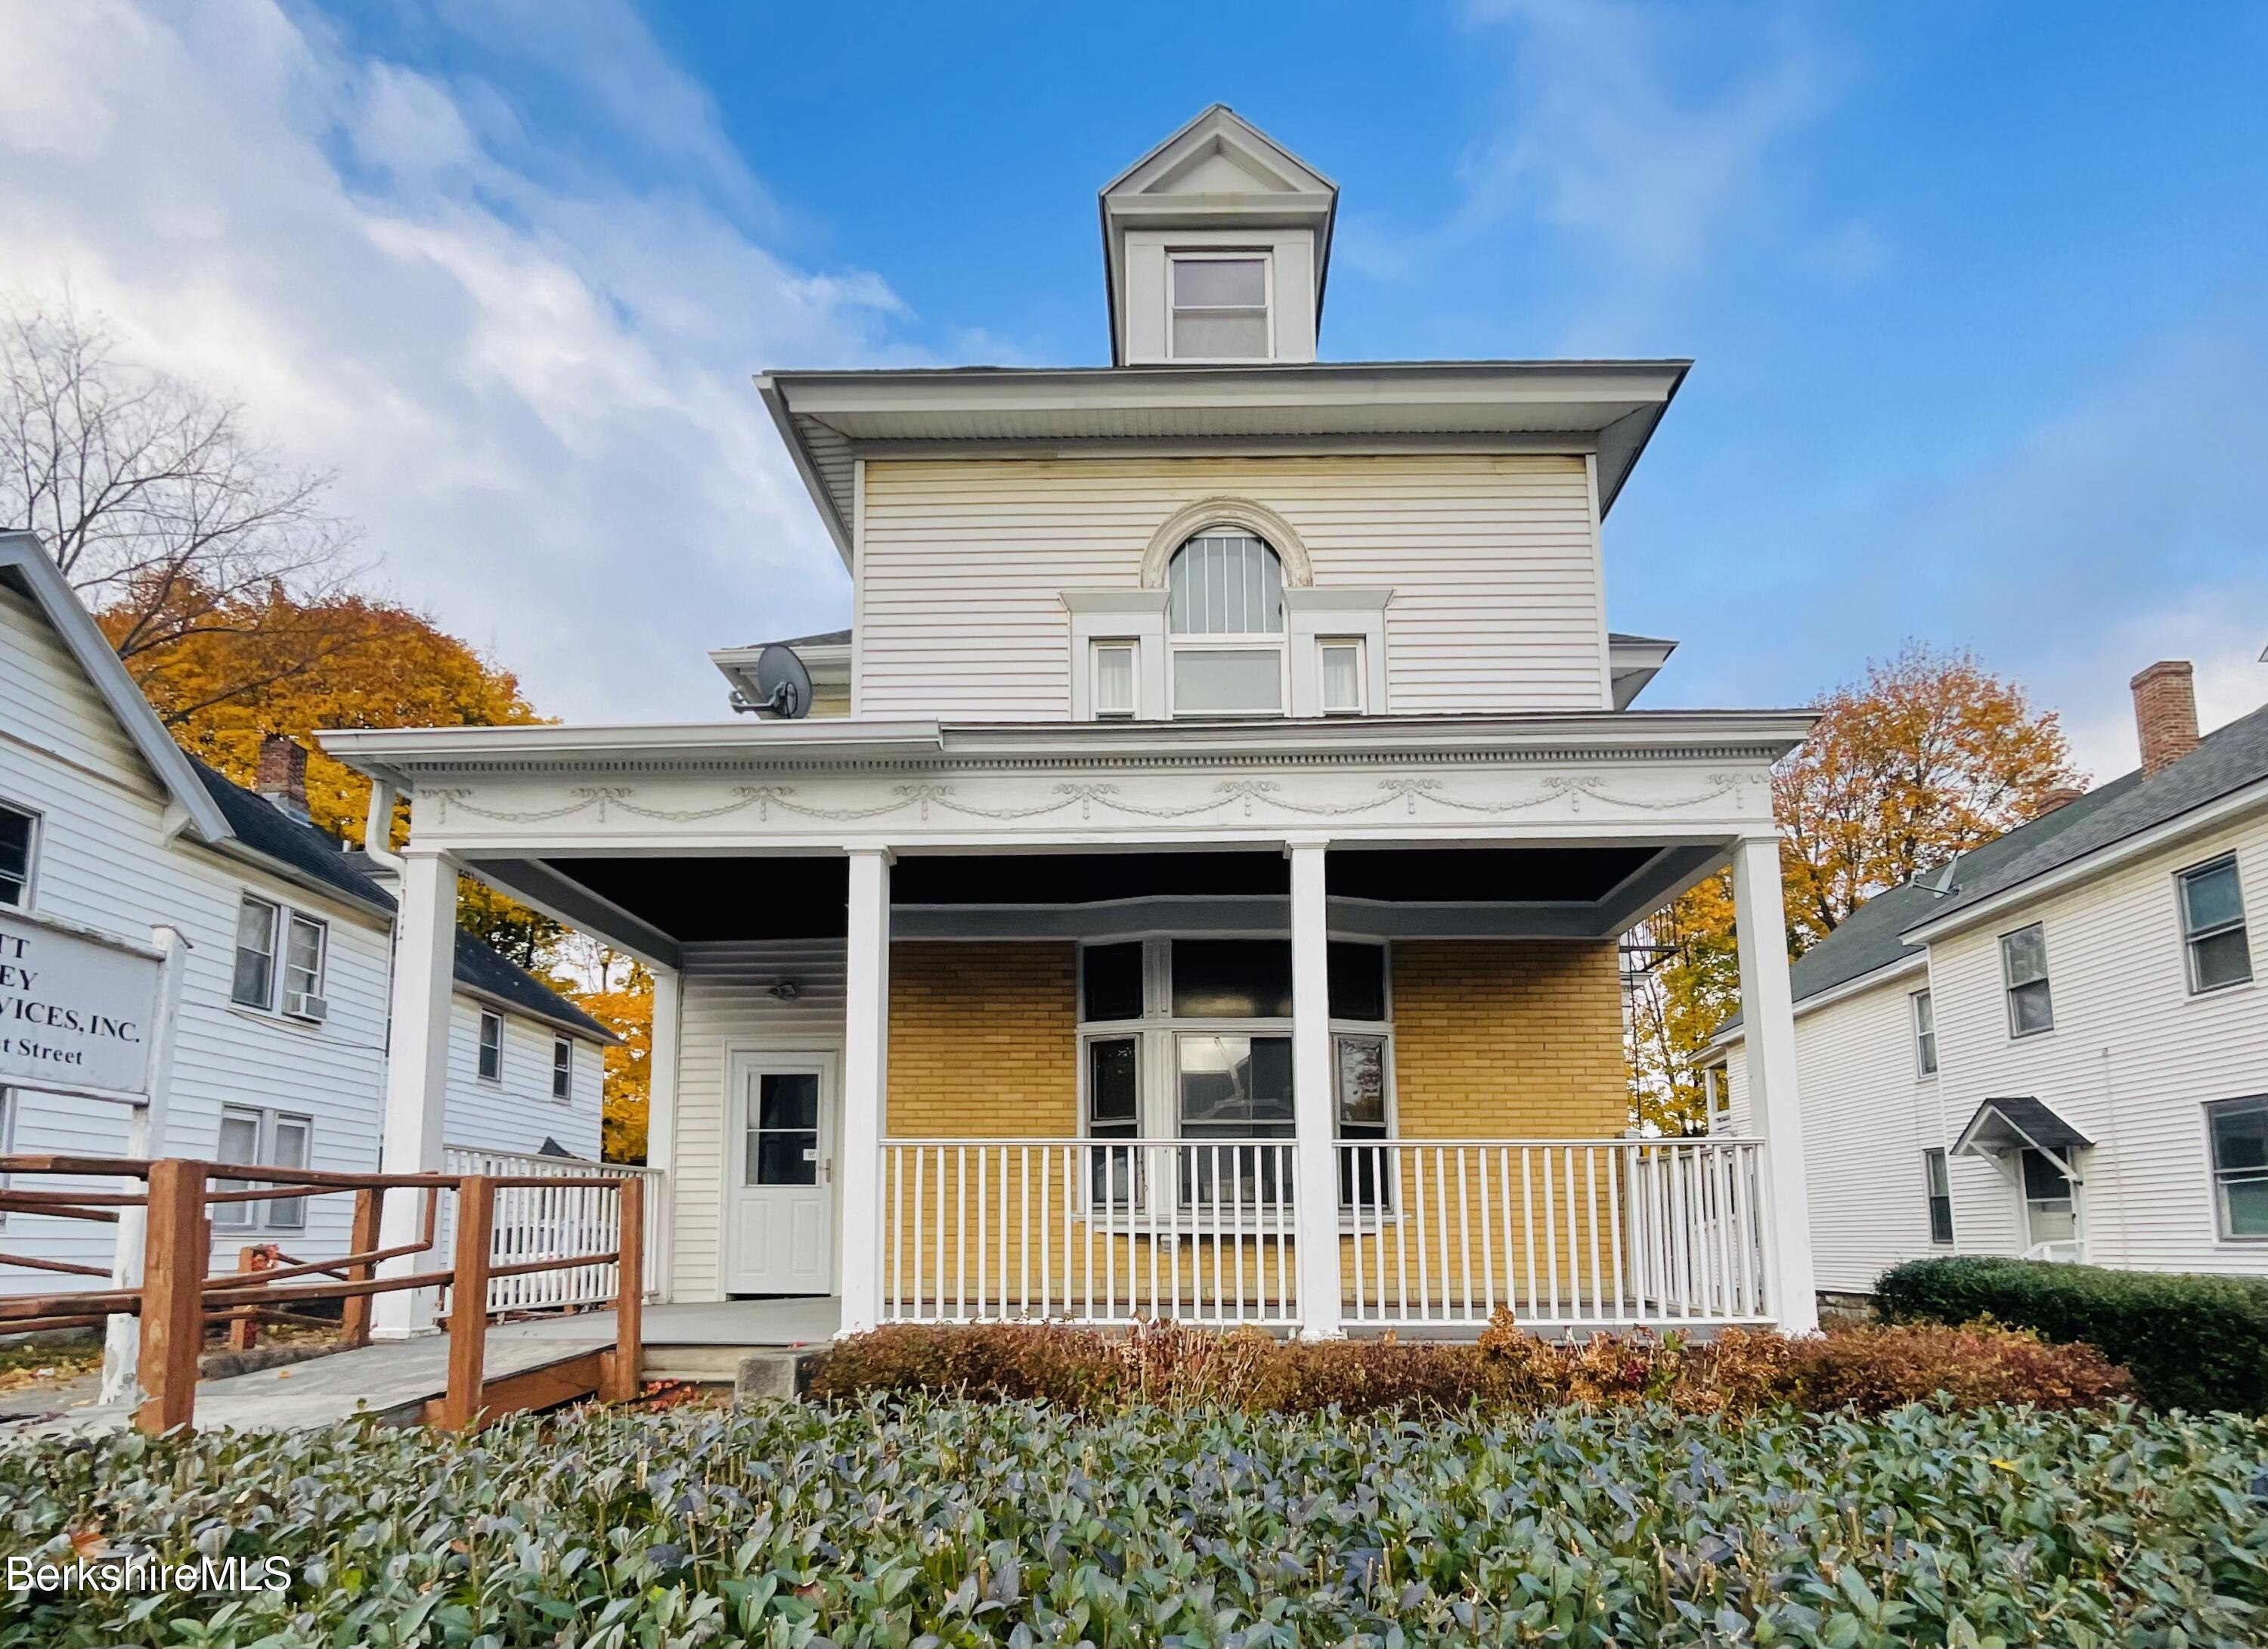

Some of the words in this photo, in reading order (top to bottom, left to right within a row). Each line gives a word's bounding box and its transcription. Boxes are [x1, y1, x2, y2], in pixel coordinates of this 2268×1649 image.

[0, 965, 39, 990] EY
[89, 1015, 140, 1043] INC.
[17, 1038, 82, 1065] Street
